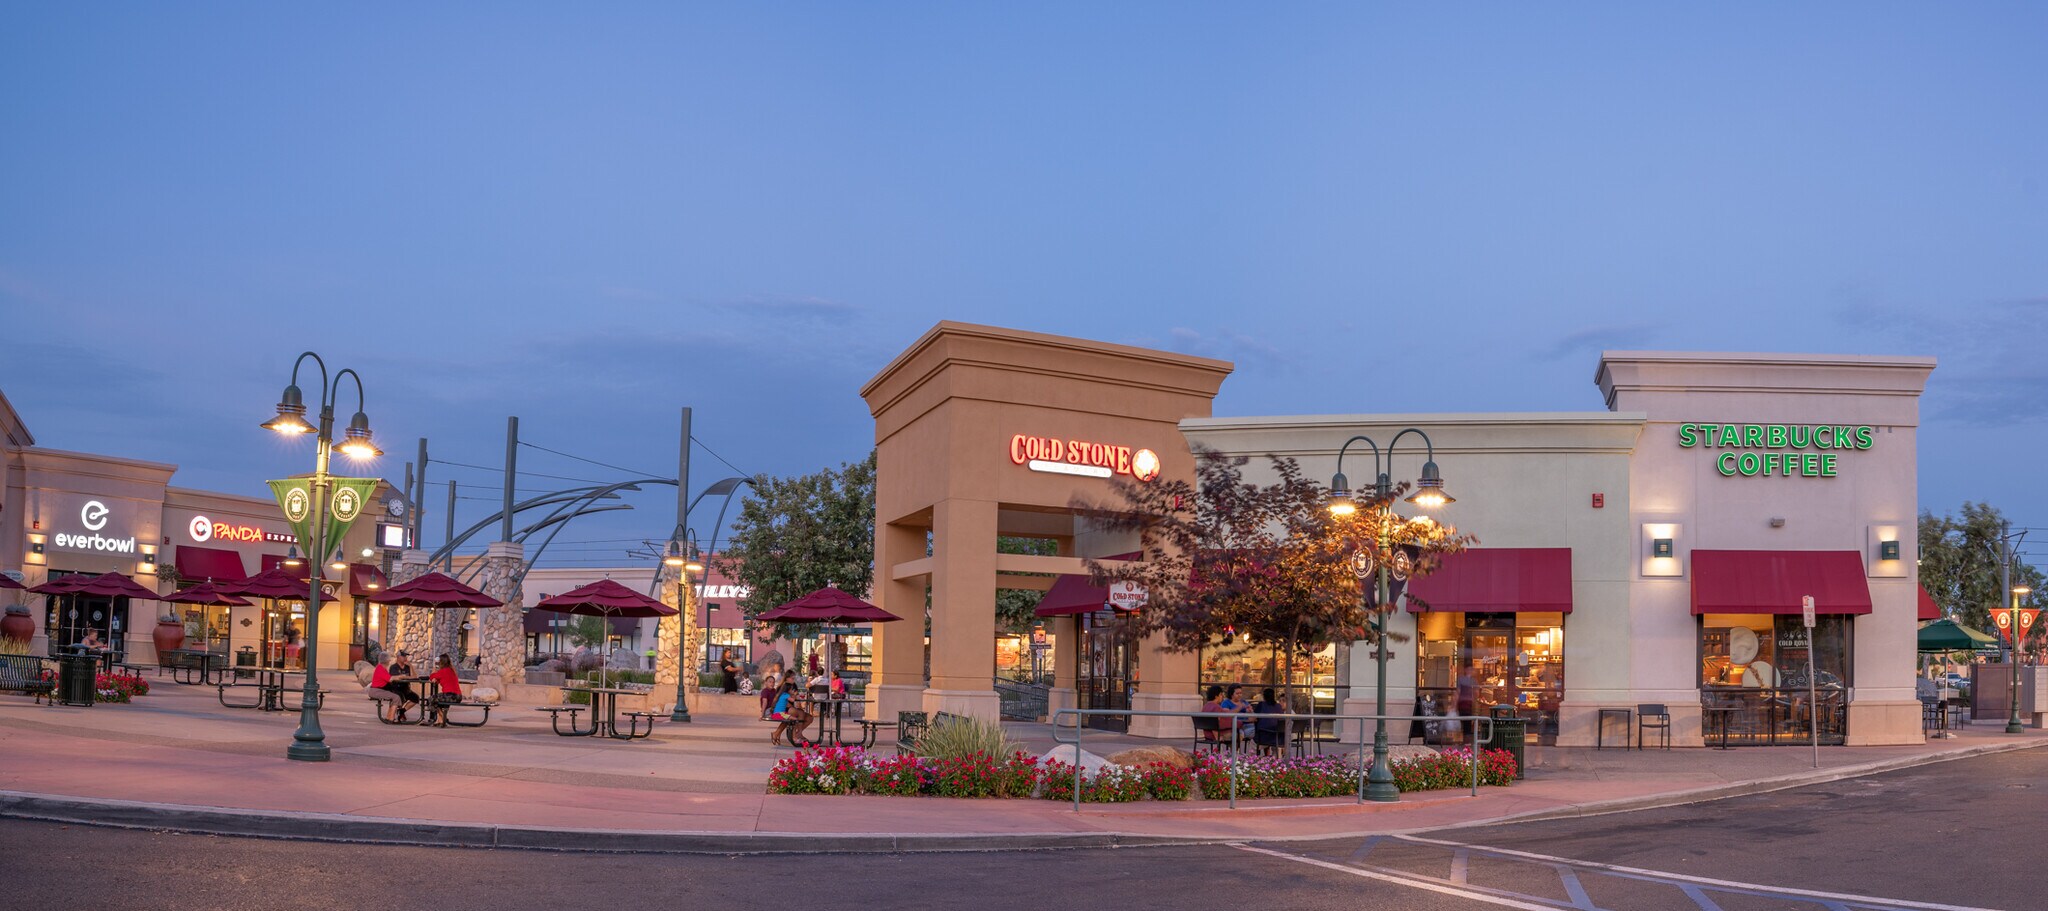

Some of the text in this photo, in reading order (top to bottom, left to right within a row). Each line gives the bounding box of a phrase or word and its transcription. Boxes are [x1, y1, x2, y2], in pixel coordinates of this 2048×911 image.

[1679, 423, 1874, 449] STARBUCKS
[1011, 434, 1131, 475] COLD STONE
[1717, 452, 1838, 477] COFFEE
[55, 532, 135, 553] everbowl
[212, 522, 263, 543] PANDA
[1113, 593, 1127, 601] COLD
